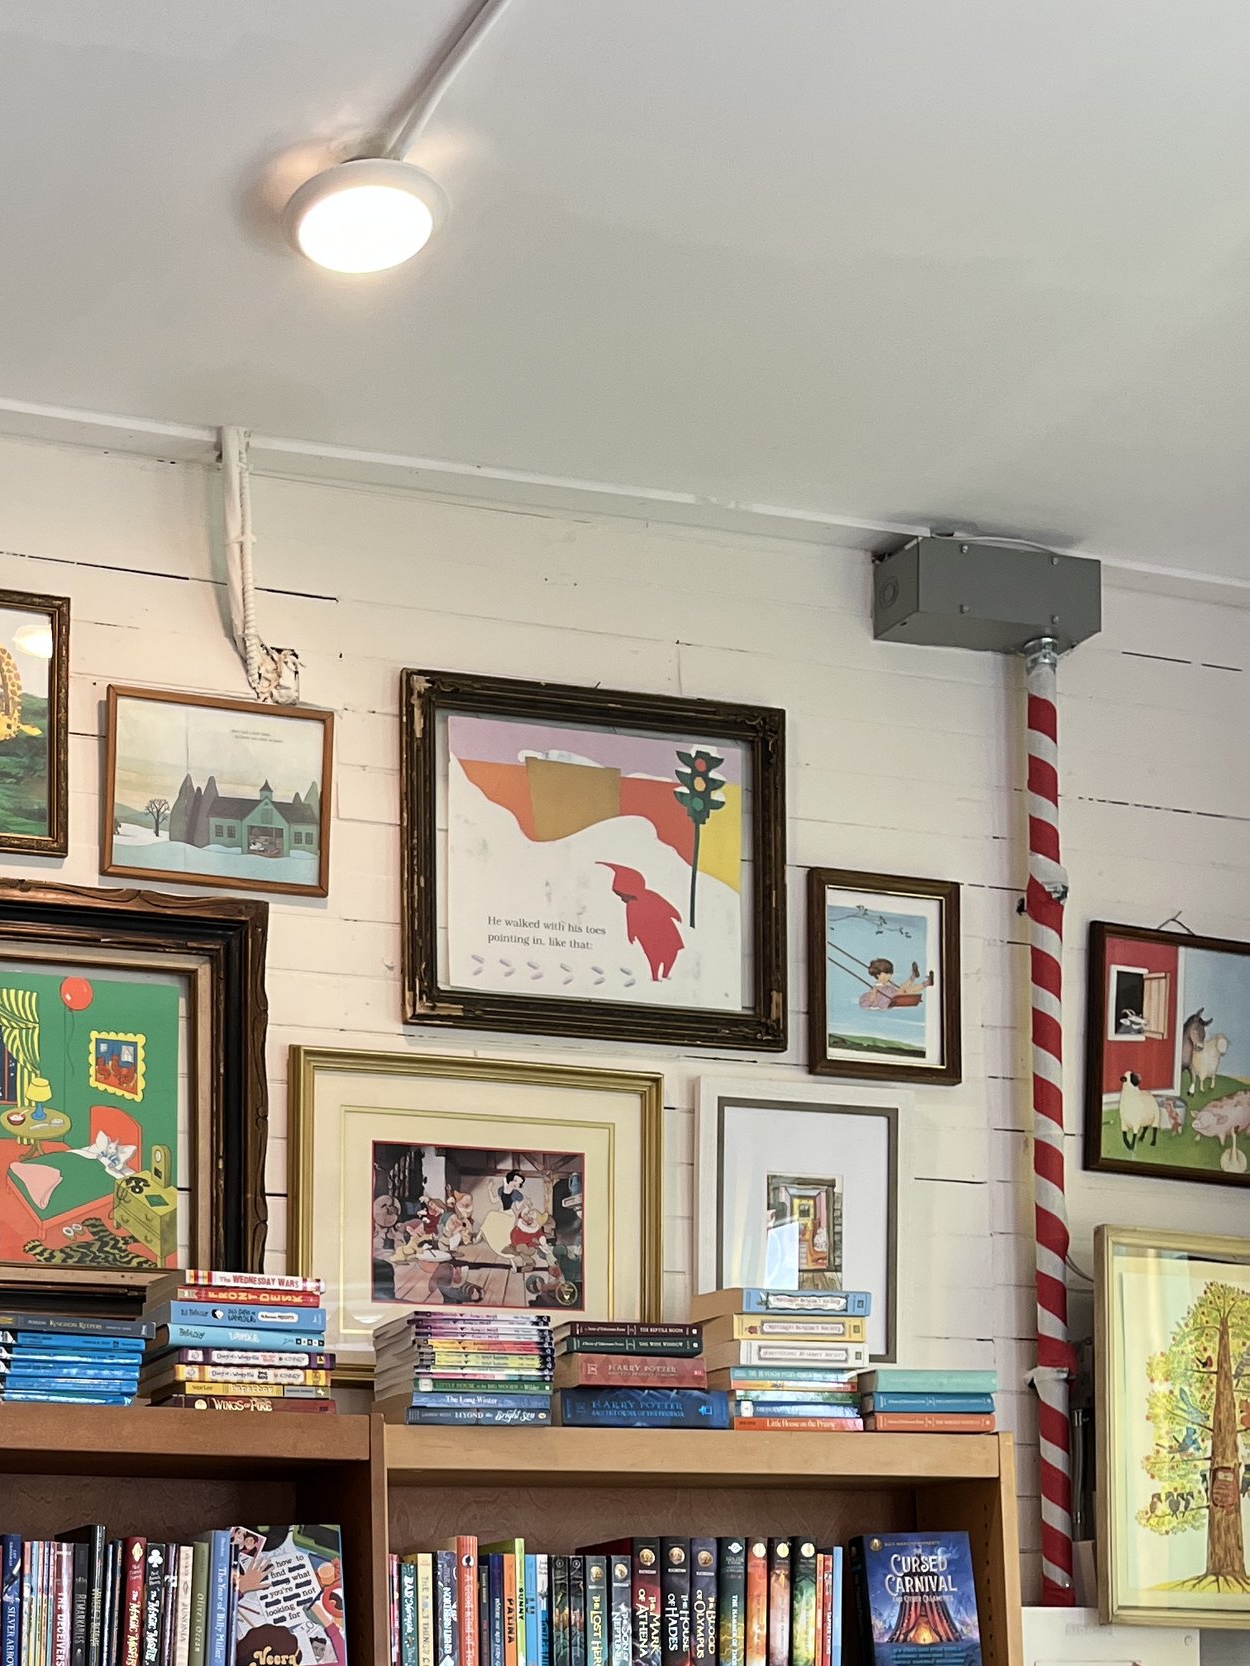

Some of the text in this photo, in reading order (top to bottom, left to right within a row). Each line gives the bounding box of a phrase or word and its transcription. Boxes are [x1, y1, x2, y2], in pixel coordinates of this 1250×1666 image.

[488, 916, 606, 936] He walked with his toes
[488, 932, 593, 949] pointing in, like that:
[220, 1275, 299, 1289] The WEDNESDAY WARS
[208, 1291, 303, 1304] FRONT DESK
[608, 1363, 677, 1373] HARRY POTTER
[212, 1398, 244, 1411] WINGS
[276, 1554, 304, 1568] how to
[890, 1554, 948, 1578] CURSED
[271, 1569, 286, 1579] find
[292, 1570, 311, 1581] what
[269, 1585, 293, 1598] you're
[302, 1586, 316, 1596] not
[884, 1574, 958, 1596] CARNIVAL
[265, 1603, 295, 1618] looking
[288, 1610, 301, 1620] for
[253, 1646, 301, 1666] Veera
